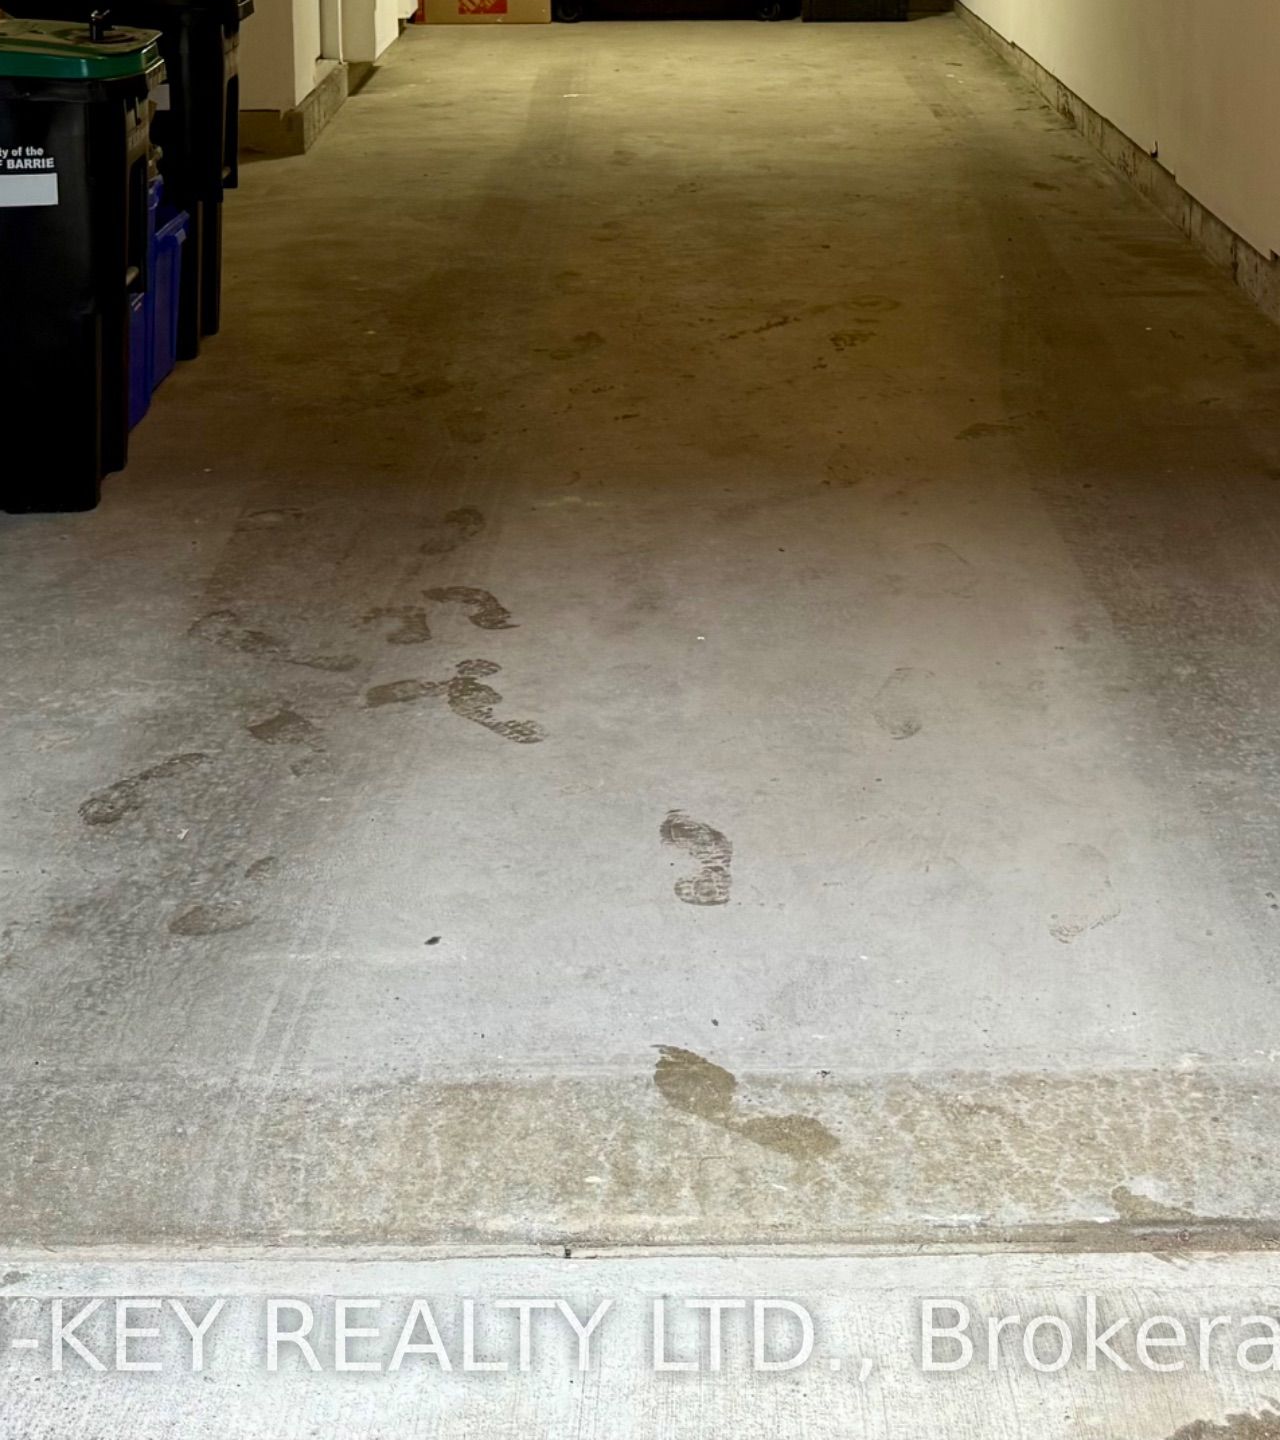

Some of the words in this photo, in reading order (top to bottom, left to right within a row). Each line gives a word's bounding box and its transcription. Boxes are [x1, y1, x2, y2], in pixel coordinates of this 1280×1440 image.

[11, 146, 23, 157] of
[25, 146, 44, 157] the
[6, 157, 55, 169] BARRIE
